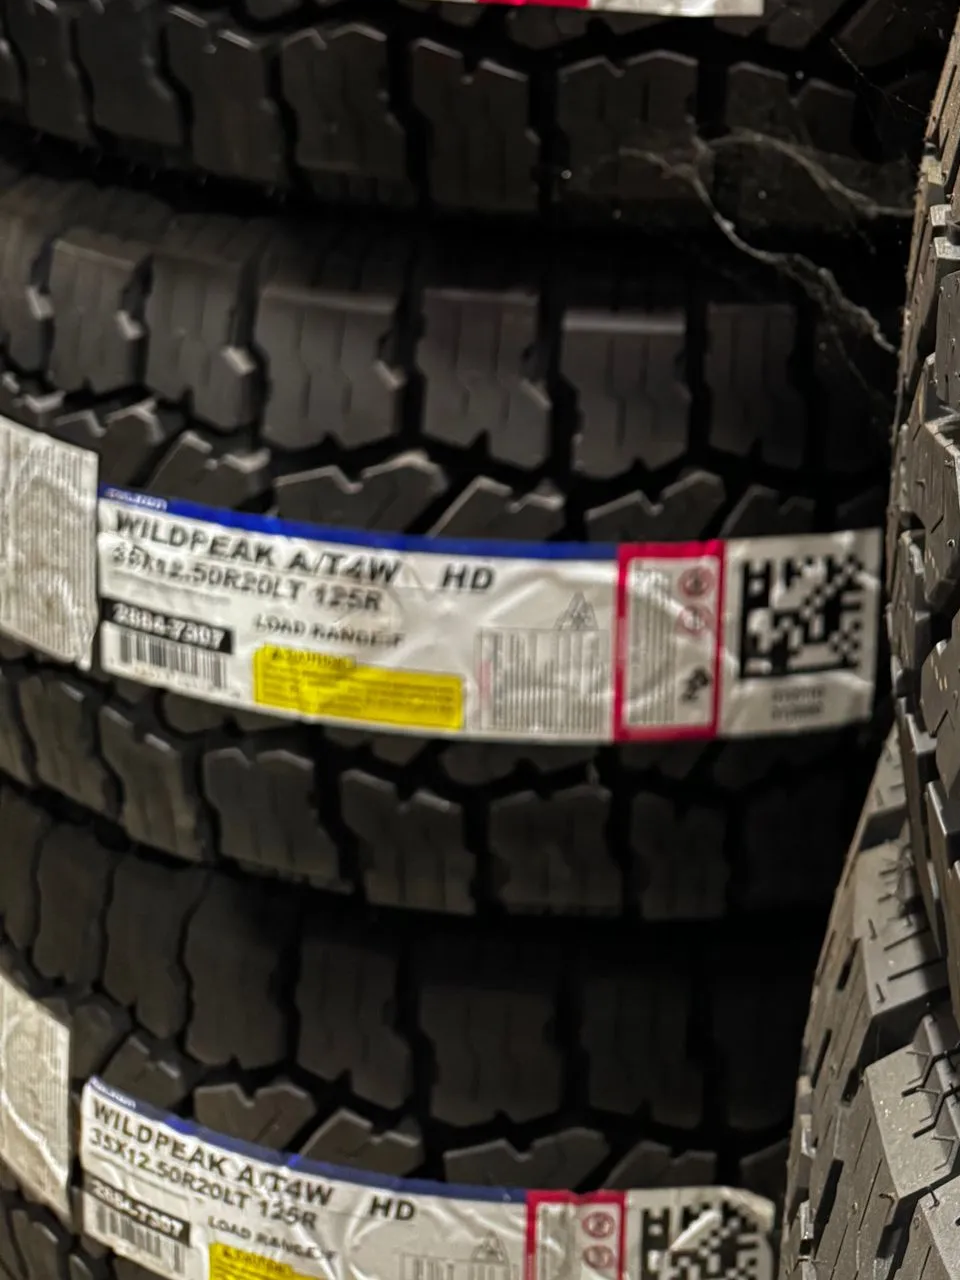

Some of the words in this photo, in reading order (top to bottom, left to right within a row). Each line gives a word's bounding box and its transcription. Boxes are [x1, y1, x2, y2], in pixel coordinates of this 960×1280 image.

[115, 508, 275, 567] WILDPEAK
[289, 552, 400, 584] A/T4W
[442, 565, 494, 591] HD
[314, 584, 384, 612] 125R
[256, 613, 306, 636] LOAD
[91, 1097, 229, 1175] WILDPEAK
[238, 1163, 335, 1207] A/T4W
[370, 1196, 416, 1222] HD
[208, 1215, 252, 1241] LOAD
[258, 1197, 319, 1230] 125R
